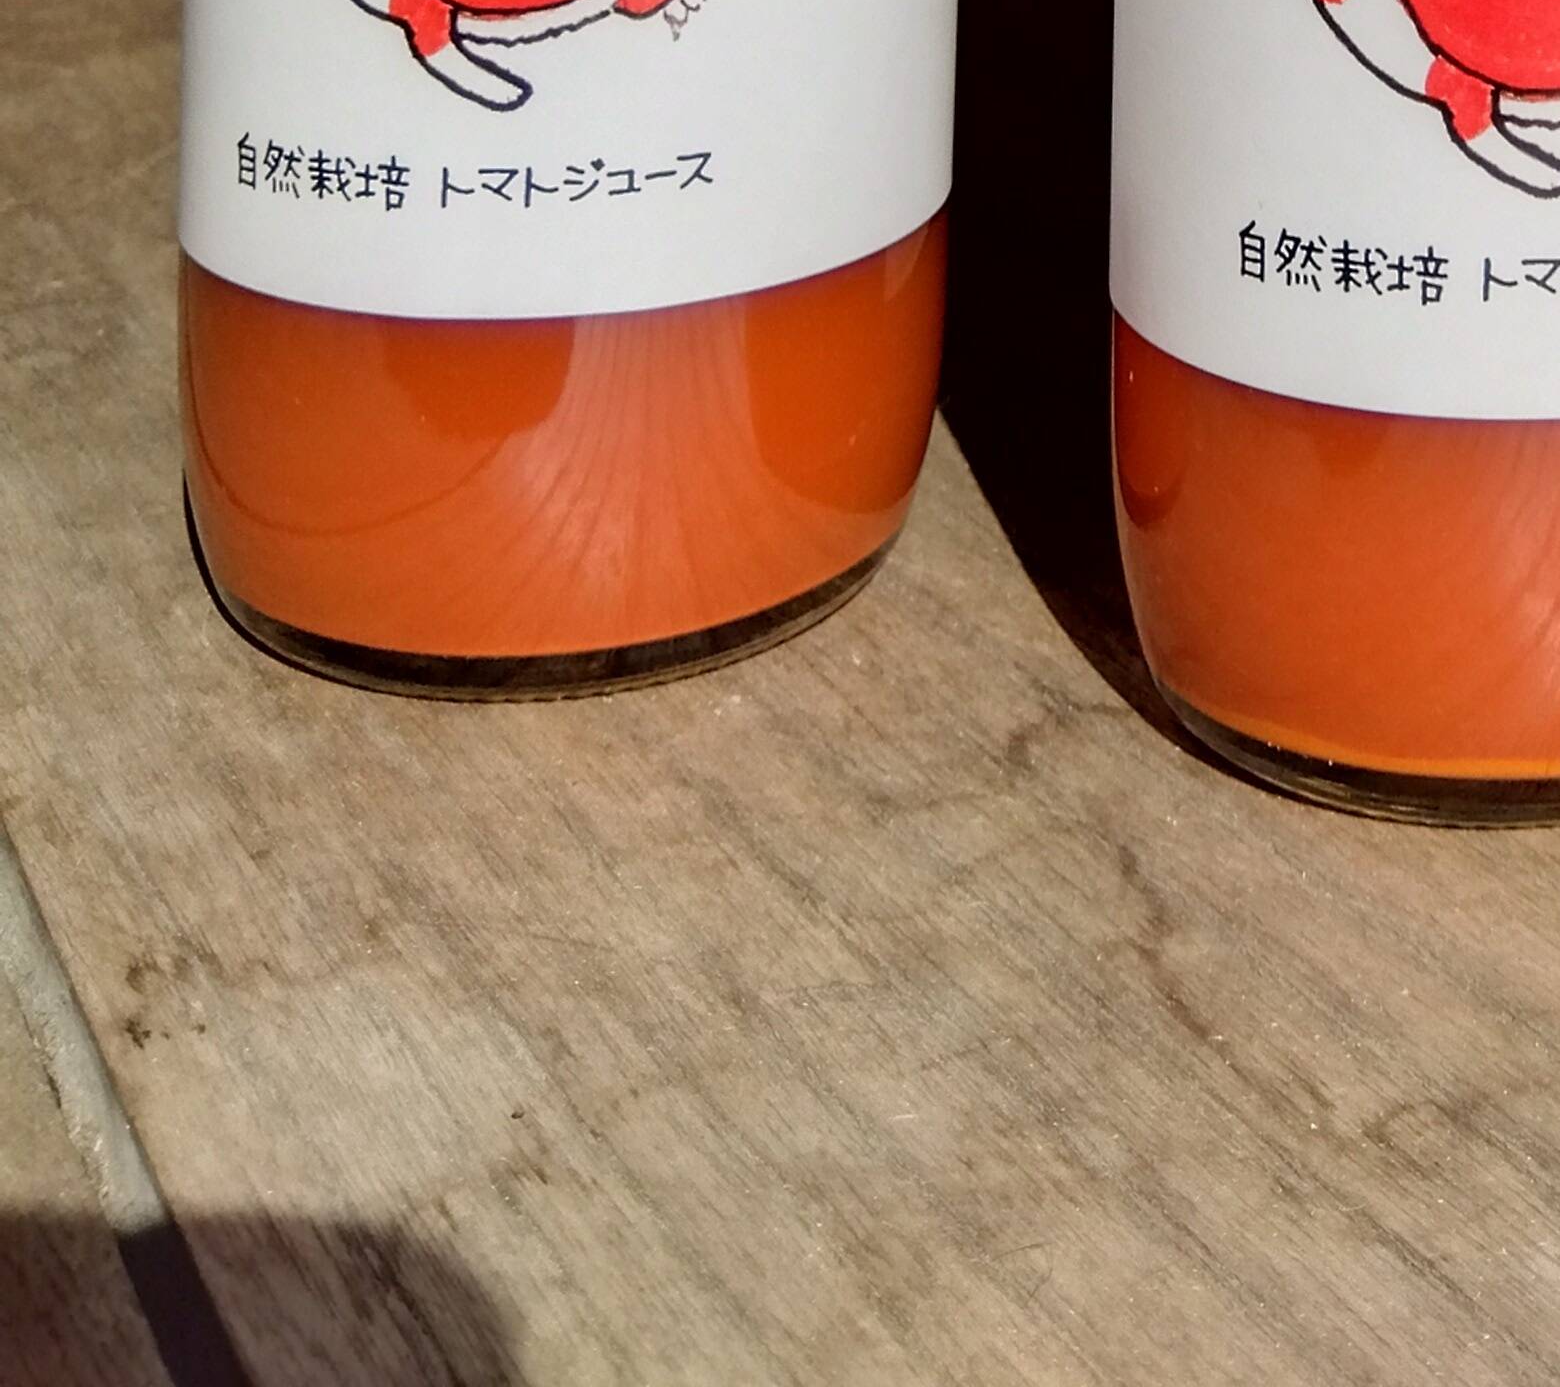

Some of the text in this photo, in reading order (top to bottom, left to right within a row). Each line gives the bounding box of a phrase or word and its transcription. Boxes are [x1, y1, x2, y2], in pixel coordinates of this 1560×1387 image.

[236, 130, 715, 212] 自然栽培 トマトジュース
[1238, 219, 1450, 307] 自然栽培
